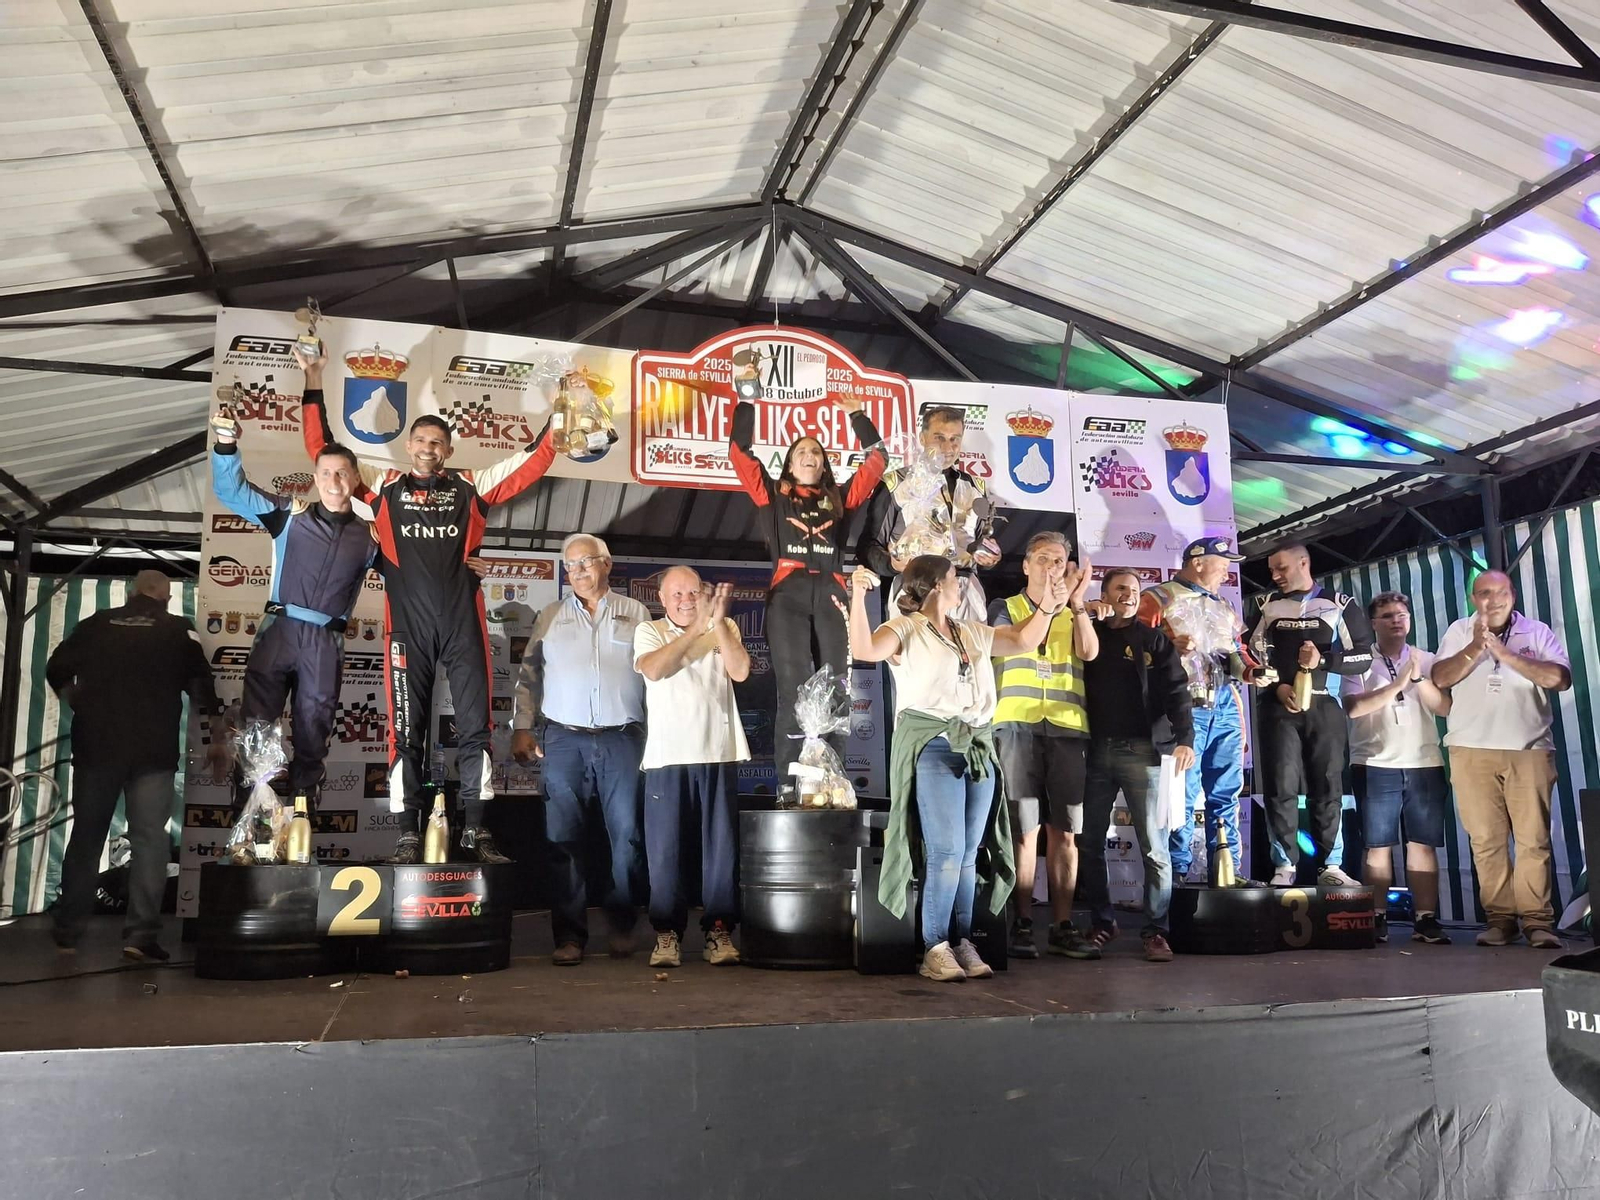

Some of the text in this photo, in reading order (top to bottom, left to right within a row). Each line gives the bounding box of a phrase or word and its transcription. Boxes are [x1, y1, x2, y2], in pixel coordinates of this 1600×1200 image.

[704, 358, 731, 371] 2025
[797, 353, 825, 364] EL PEDROSO
[767, 344, 794, 387] XII
[657, 367, 731, 384] SIERRA de SEVILLA
[827, 368, 853, 381] 2025
[777, 387, 823, 400] Octubre
[827, 381, 893, 398] SIERRA de SEVILLA
[645, 372, 731, 442] RALLYE
[261, 423, 299, 432] sevilla
[479, 441, 515, 450] sevilla
[960, 451, 986, 459] DERIA
[694, 454, 735, 471] SEVIL
[958, 461, 992, 477] IKS
[485, 562, 538, 575] ERTO
[393, 670, 404, 732] Iberian Cup
[361, 744, 388, 753] sevil
[738, 768, 774, 778] ASFALTO
[369, 815, 400, 826] SUCU
[402, 871, 482, 881] AUTODESGUACES
[328, 866, 382, 935] 2
[401, 895, 472, 918] SEVILLA
[1281, 888, 1314, 948] 3
